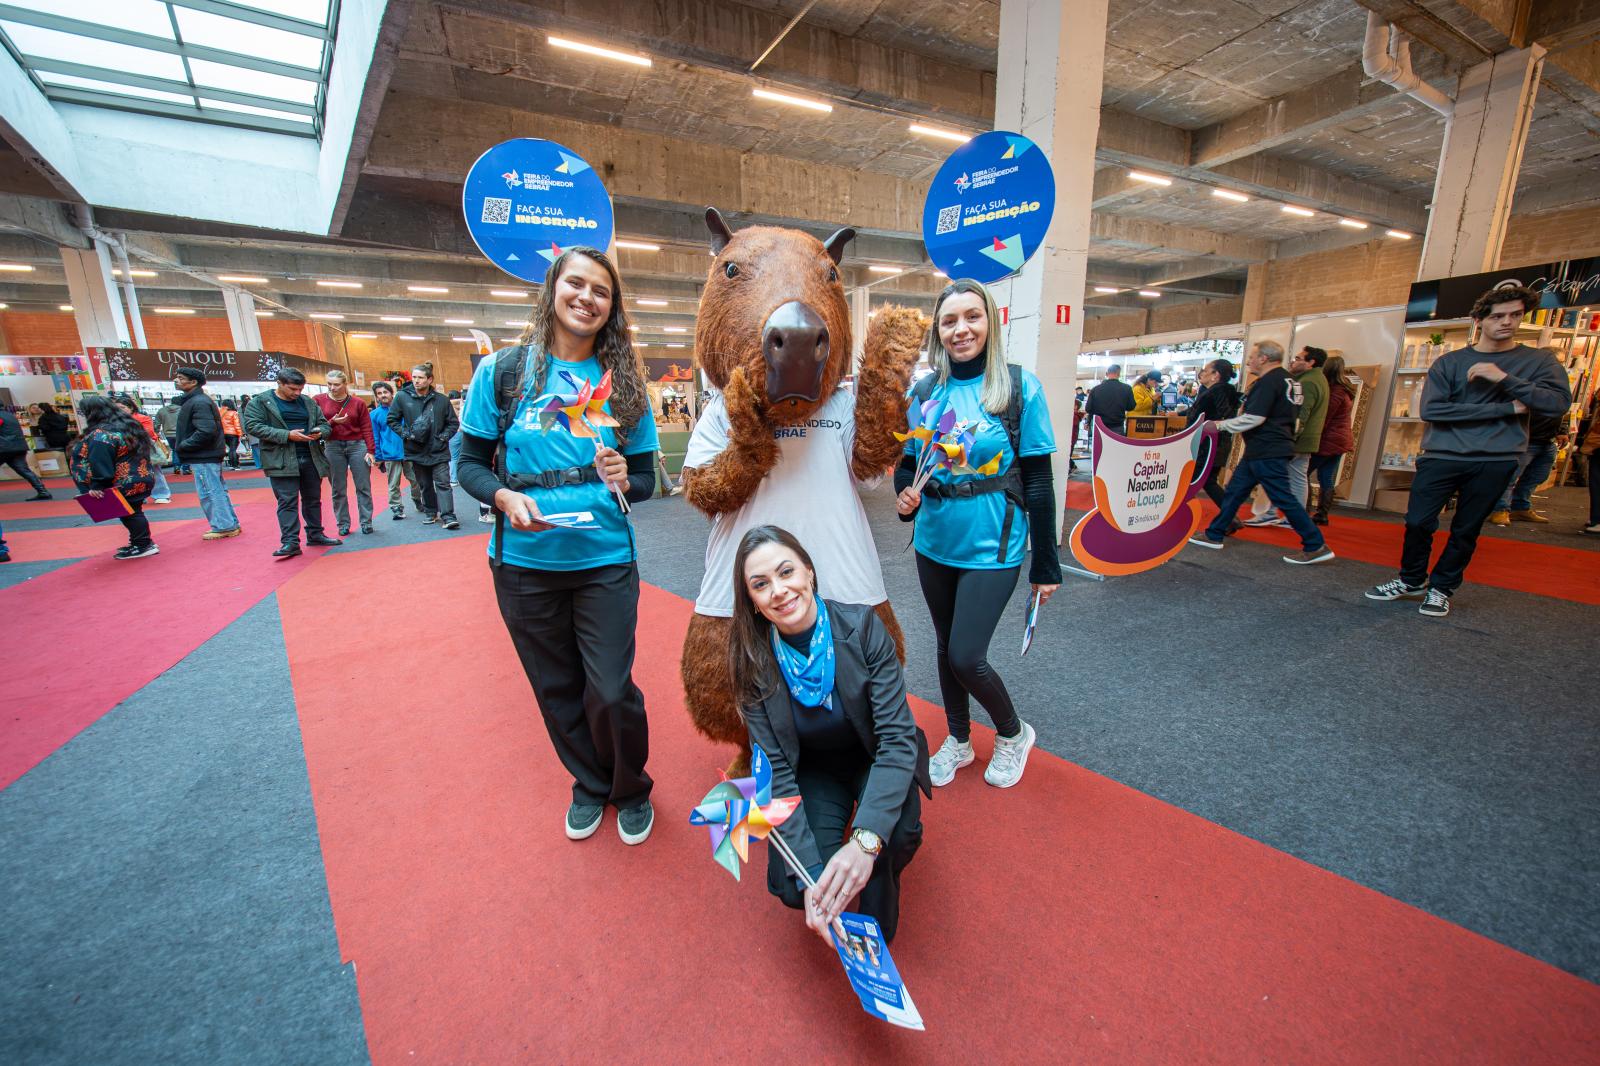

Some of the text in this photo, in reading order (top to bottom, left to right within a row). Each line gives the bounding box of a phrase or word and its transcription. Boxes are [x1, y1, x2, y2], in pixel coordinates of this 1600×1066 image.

[523, 172, 541, 180] FEIRA
[972, 169, 988, 178] FEIRA
[972, 165, 1019, 184] EMPREENDEDOR
[523, 178, 574, 188] EMPREENDEDOR
[524, 183, 551, 191] SEBRAE
[972, 177, 996, 189] SEBRAE
[516, 204, 564, 216] FAÇA SUA
[962, 201, 1040, 227] INSCRIÇÃO
[965, 198, 1007, 216] FAÇA SUA
[515, 214, 598, 230] INSCRIÇÃO
[157, 351, 237, 365] UNIQUE
[1152, 452, 1161, 460] na
[1133, 459, 1168, 480] Capital
[1127, 475, 1169, 493] Nacional
[1127, 492, 1165, 508] da Louça
